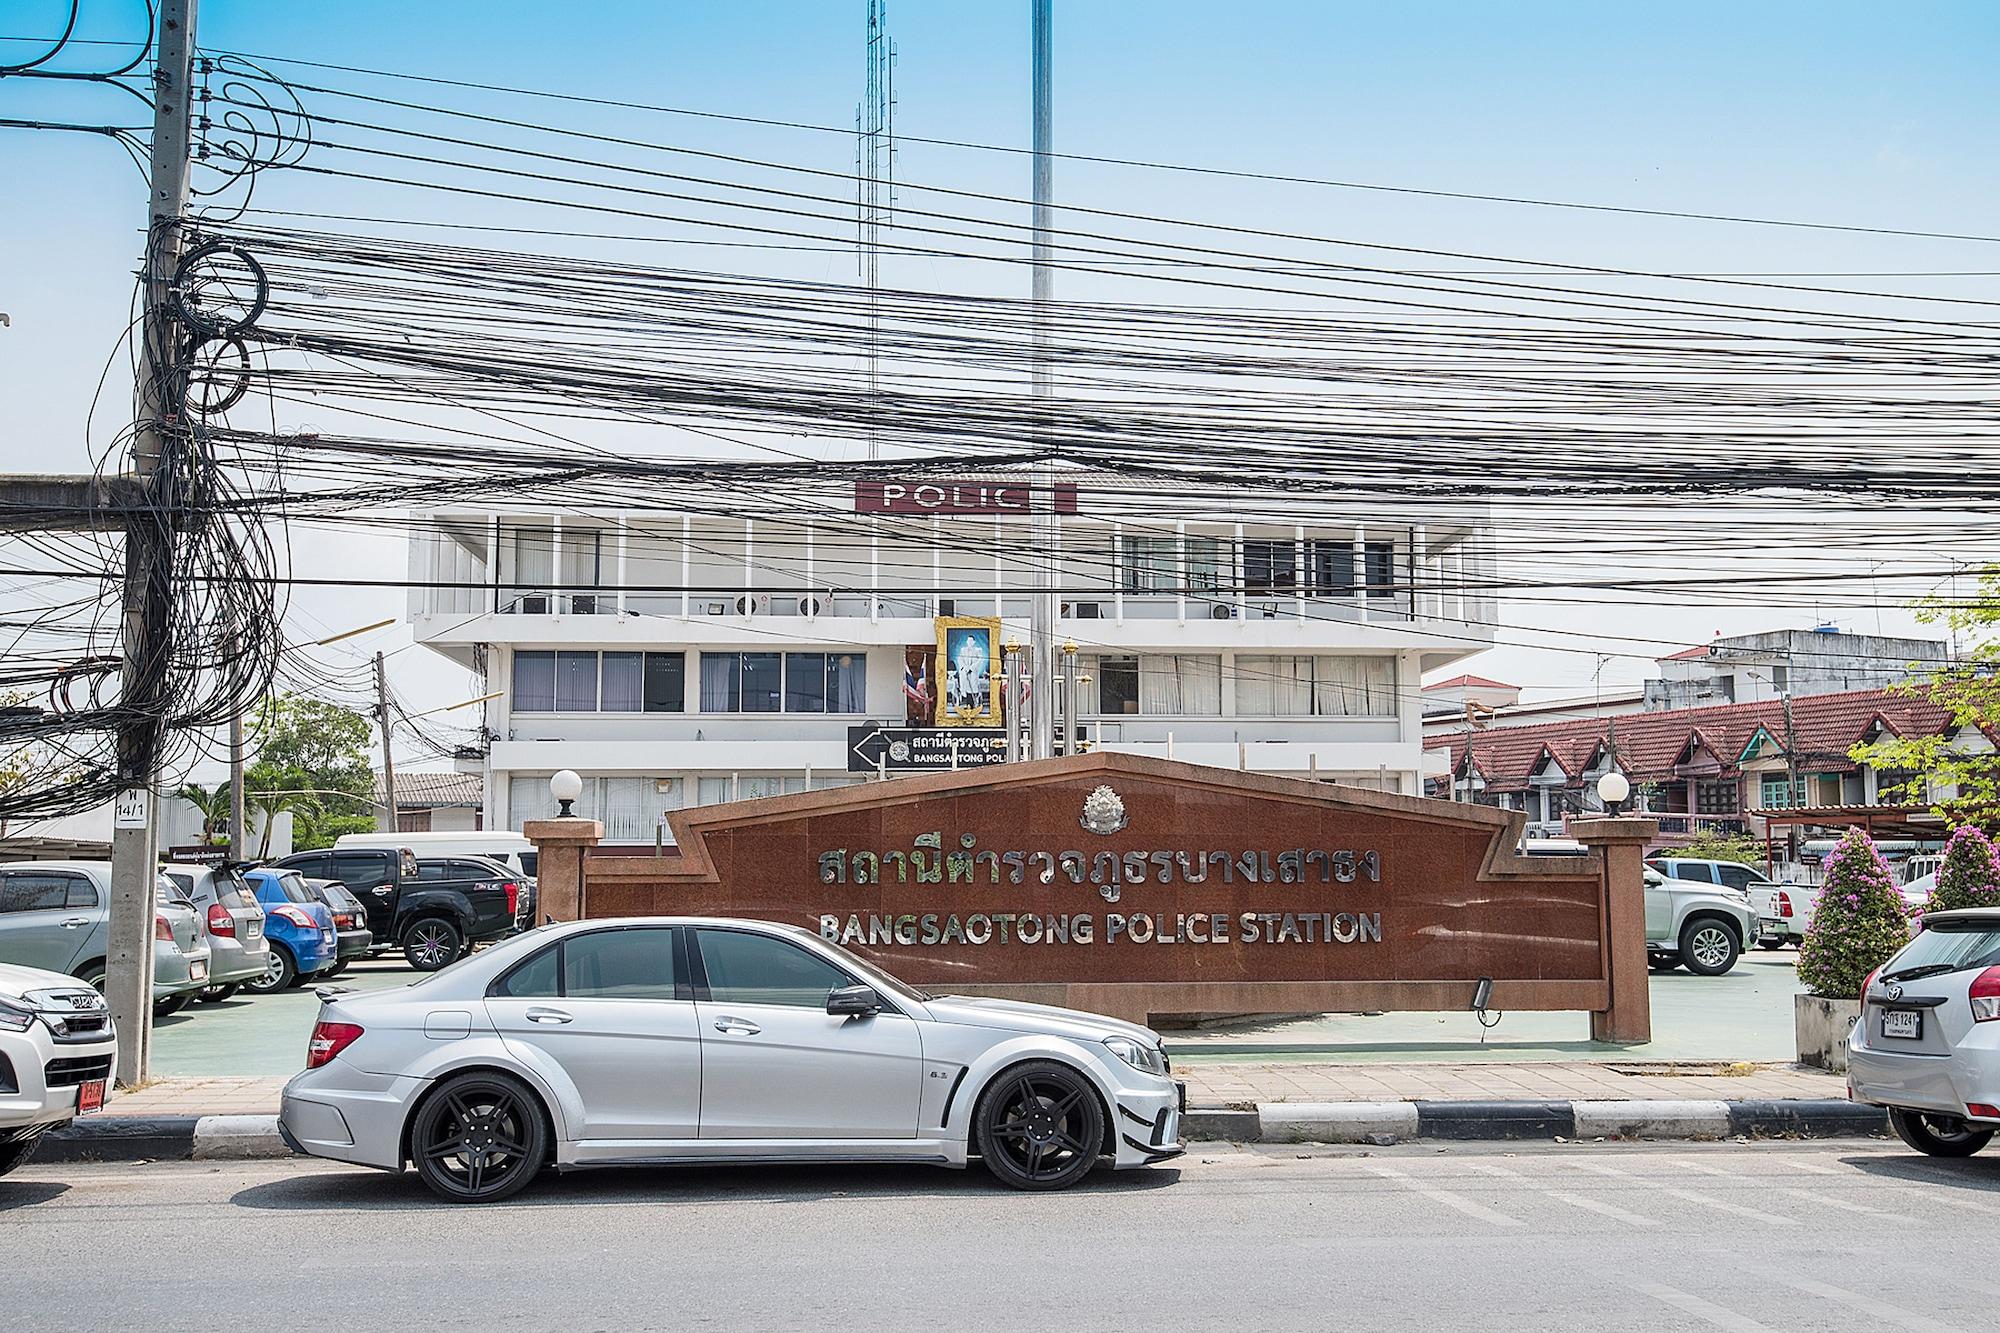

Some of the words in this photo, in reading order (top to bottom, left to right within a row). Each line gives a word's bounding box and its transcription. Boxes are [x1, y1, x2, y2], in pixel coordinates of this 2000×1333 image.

[883, 484, 1022, 508] POLIC
[912, 732, 995, 753] สถานีตำรวจภู
[913, 754, 983, 763] BANGSATONG
[116, 803, 143, 817] 14/1
[817, 831, 1381, 903] สถานีตำรวจภูธรบางเสาธง
[819, 913, 1094, 945] BANGSAOTONG
[1106, 912, 1230, 944] POLICE
[1239, 912, 1382, 944] STATION
[1900, 1013, 1916, 1026] 1241
